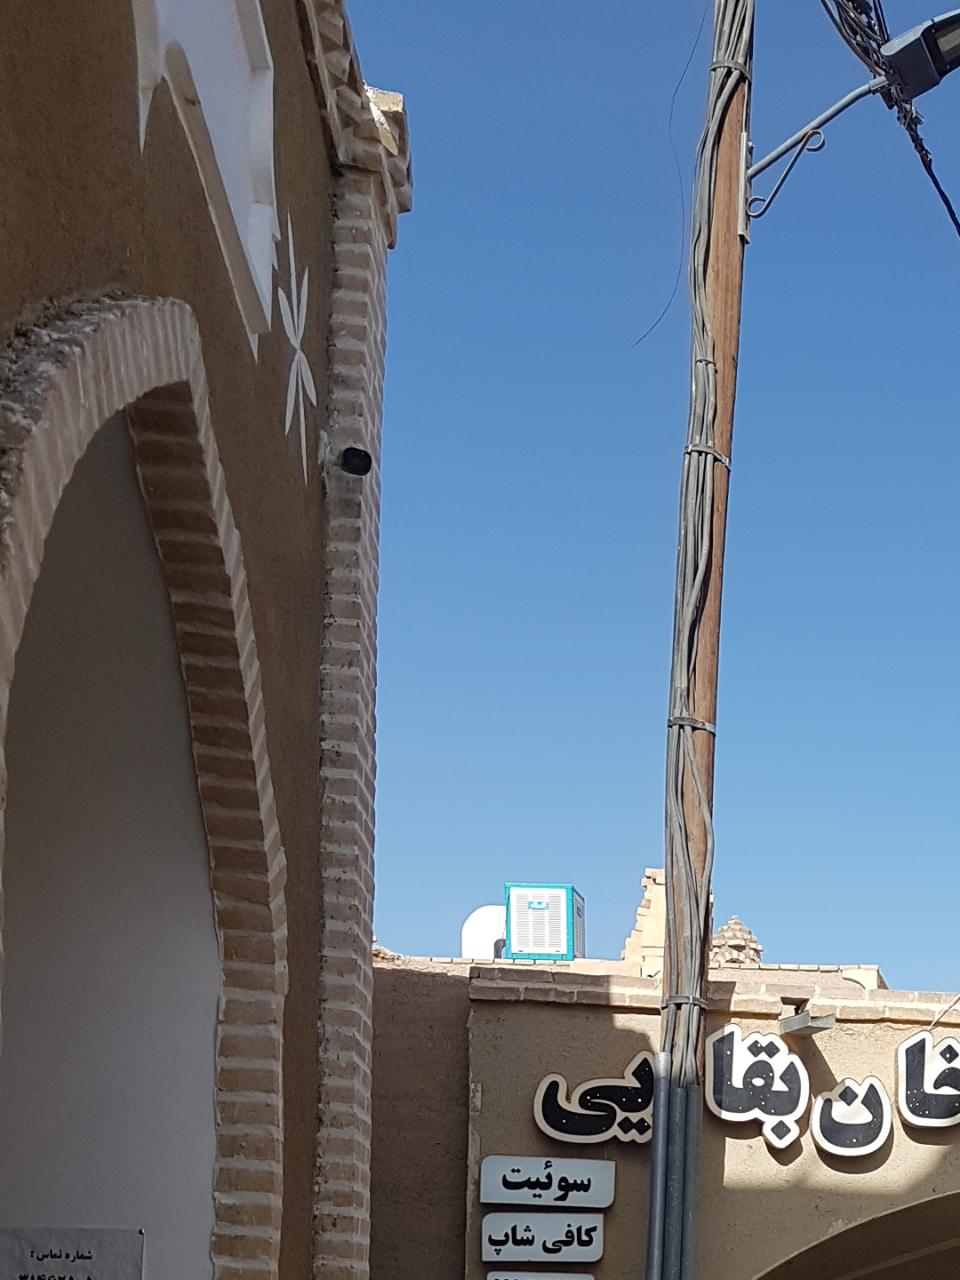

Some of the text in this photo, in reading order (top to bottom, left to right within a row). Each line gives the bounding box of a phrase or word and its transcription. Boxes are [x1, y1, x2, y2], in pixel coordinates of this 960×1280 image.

[501, 1159, 592, 1202] سوئیت
[487, 1223, 598, 1256] کافی شاپ
